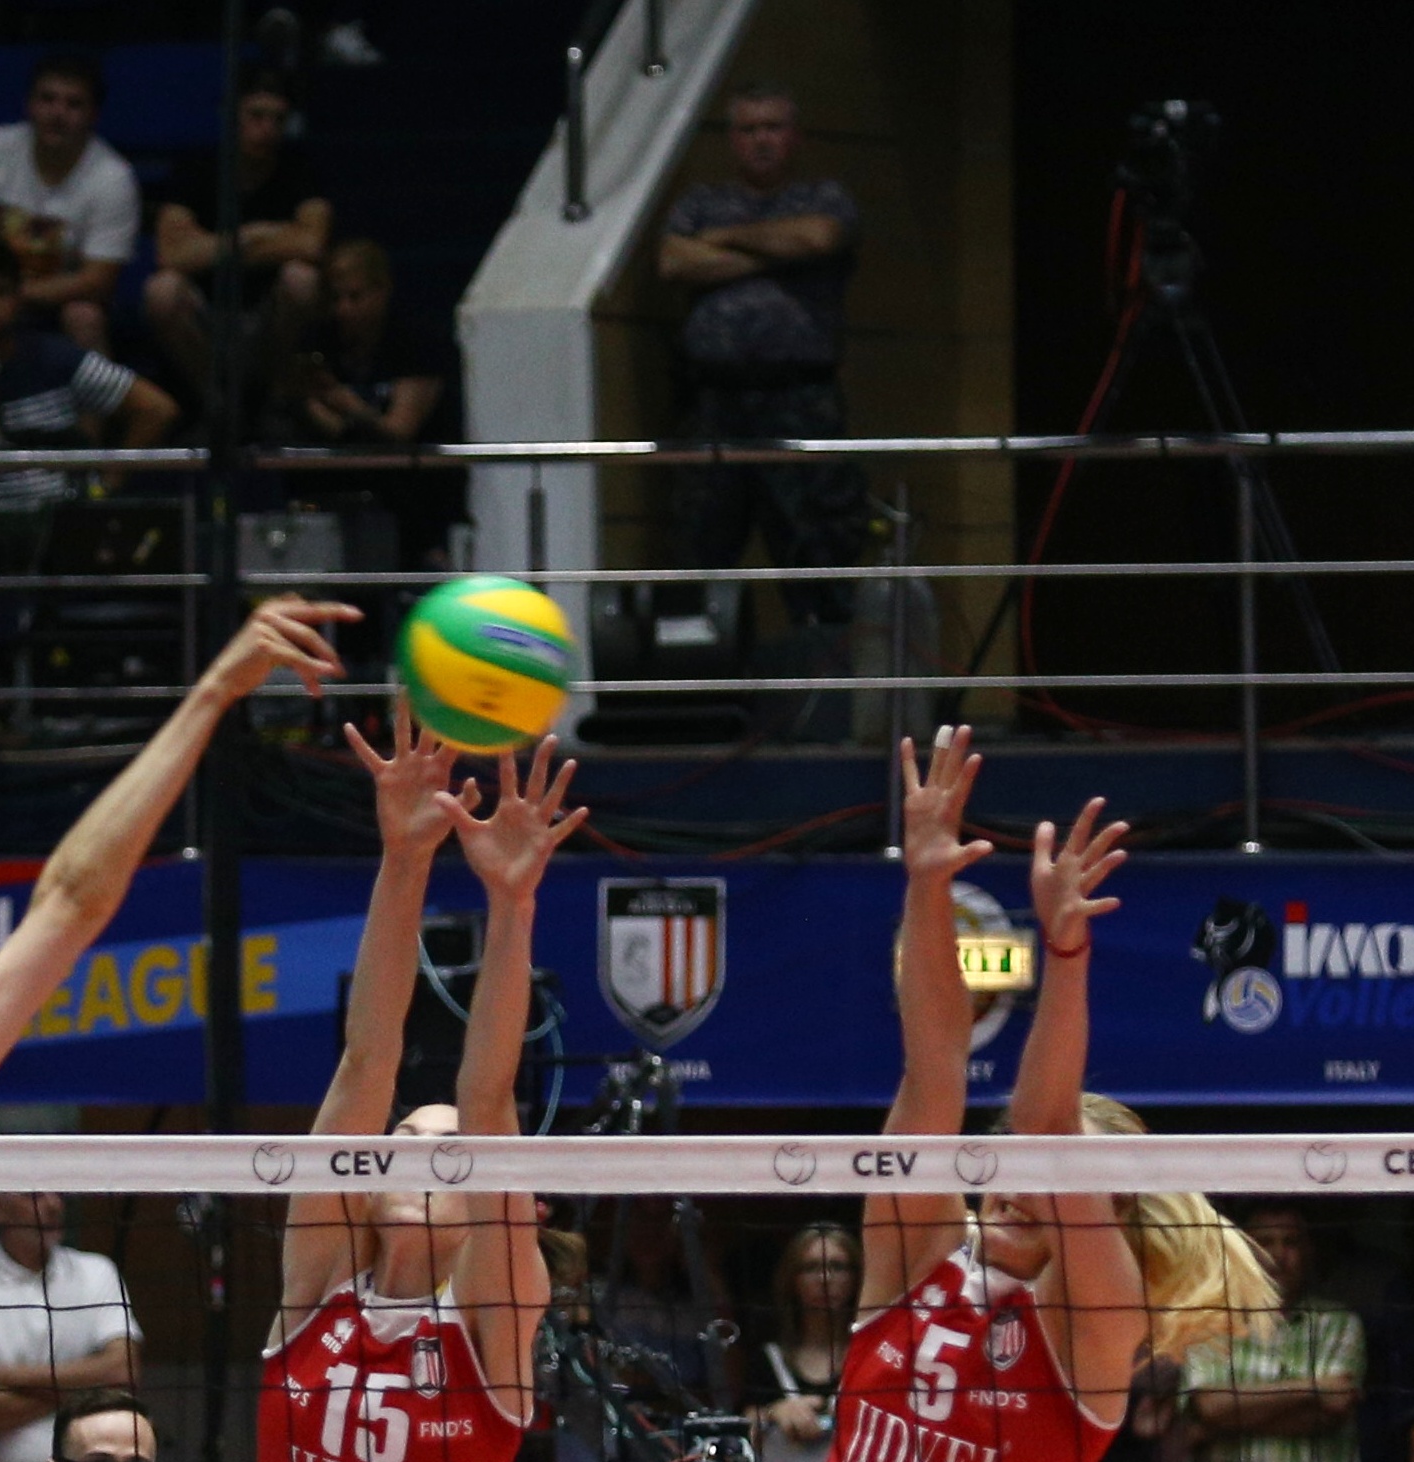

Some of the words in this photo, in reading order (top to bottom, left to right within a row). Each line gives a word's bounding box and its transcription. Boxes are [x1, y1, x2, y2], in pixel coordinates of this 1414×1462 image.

[330, 1150, 395, 1177] CEV
[852, 1151, 918, 1177] CEV
[907, 1322, 973, 1422] 5
[418, 1419, 474, 1438] FND'S
